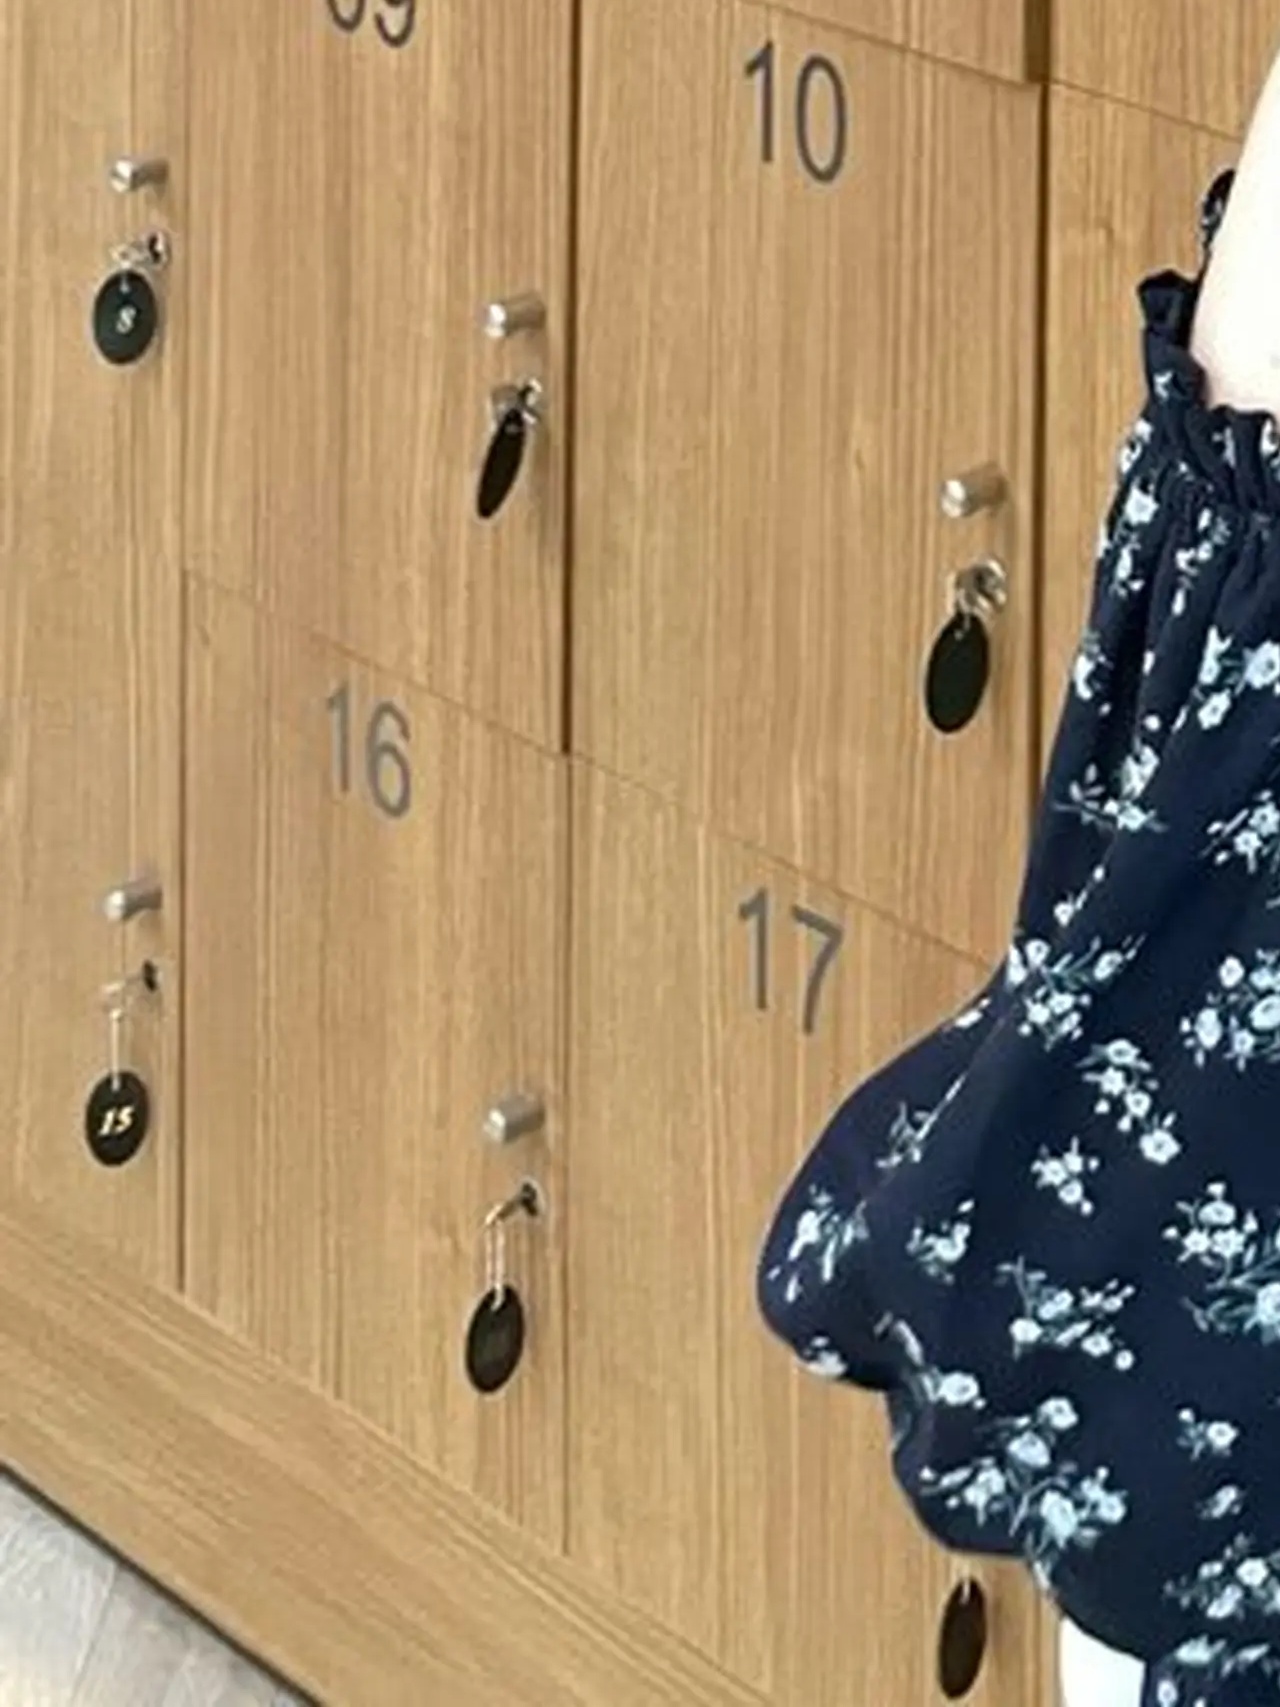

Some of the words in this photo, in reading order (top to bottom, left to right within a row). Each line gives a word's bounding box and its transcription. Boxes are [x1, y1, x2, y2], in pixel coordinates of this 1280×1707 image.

[744, 39, 847, 184] 10
[326, 680, 412, 819] 16
[738, 887, 846, 1035] 17
[98, 1104, 135, 1137] 15
